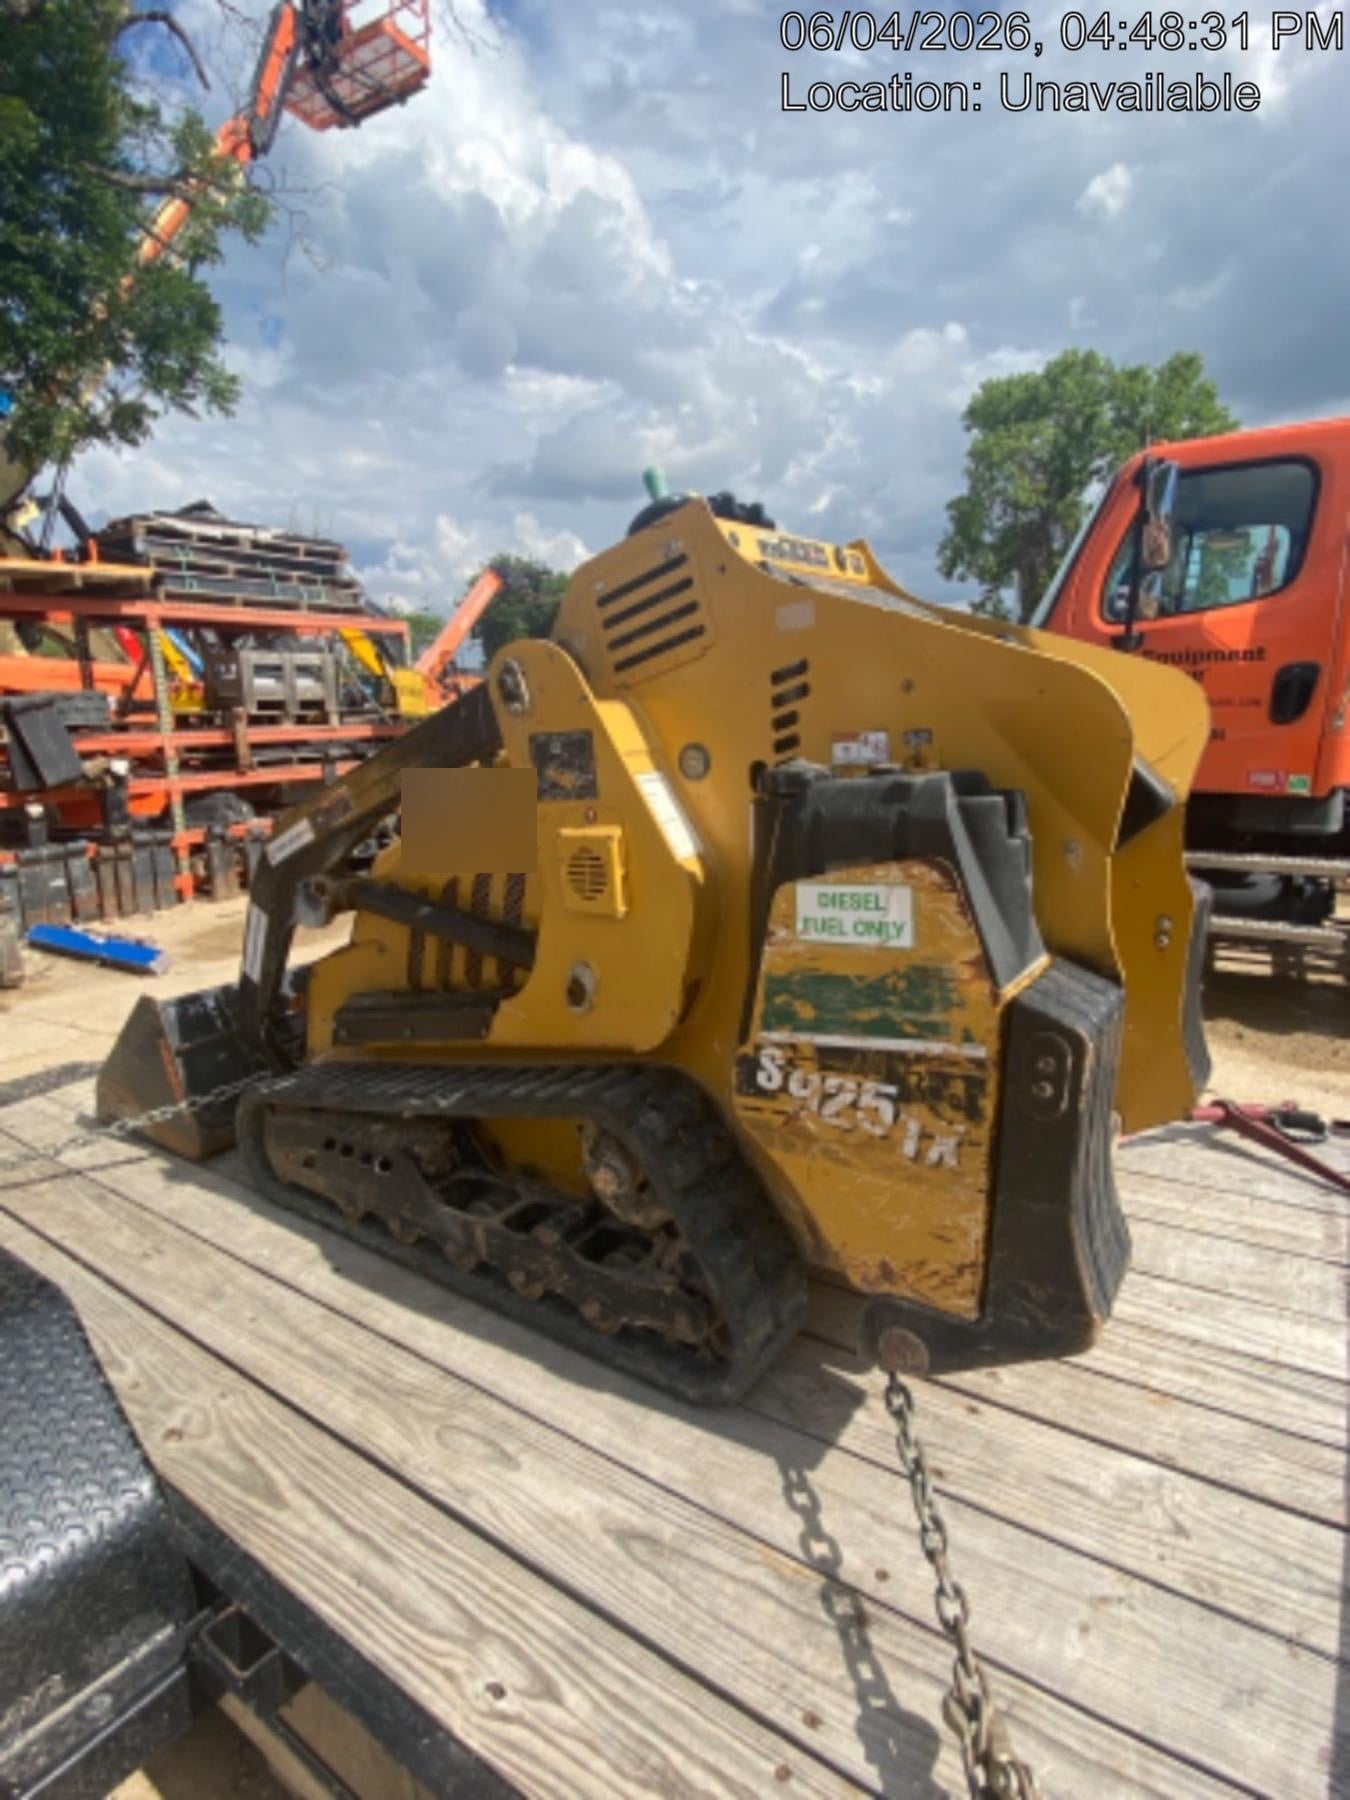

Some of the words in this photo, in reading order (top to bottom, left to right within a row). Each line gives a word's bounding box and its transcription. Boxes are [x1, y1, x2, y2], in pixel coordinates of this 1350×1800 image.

[817, 890, 887, 911] DIESEL
[801, 915, 848, 937] FUEL
[853, 919, 907, 940] ONLY
